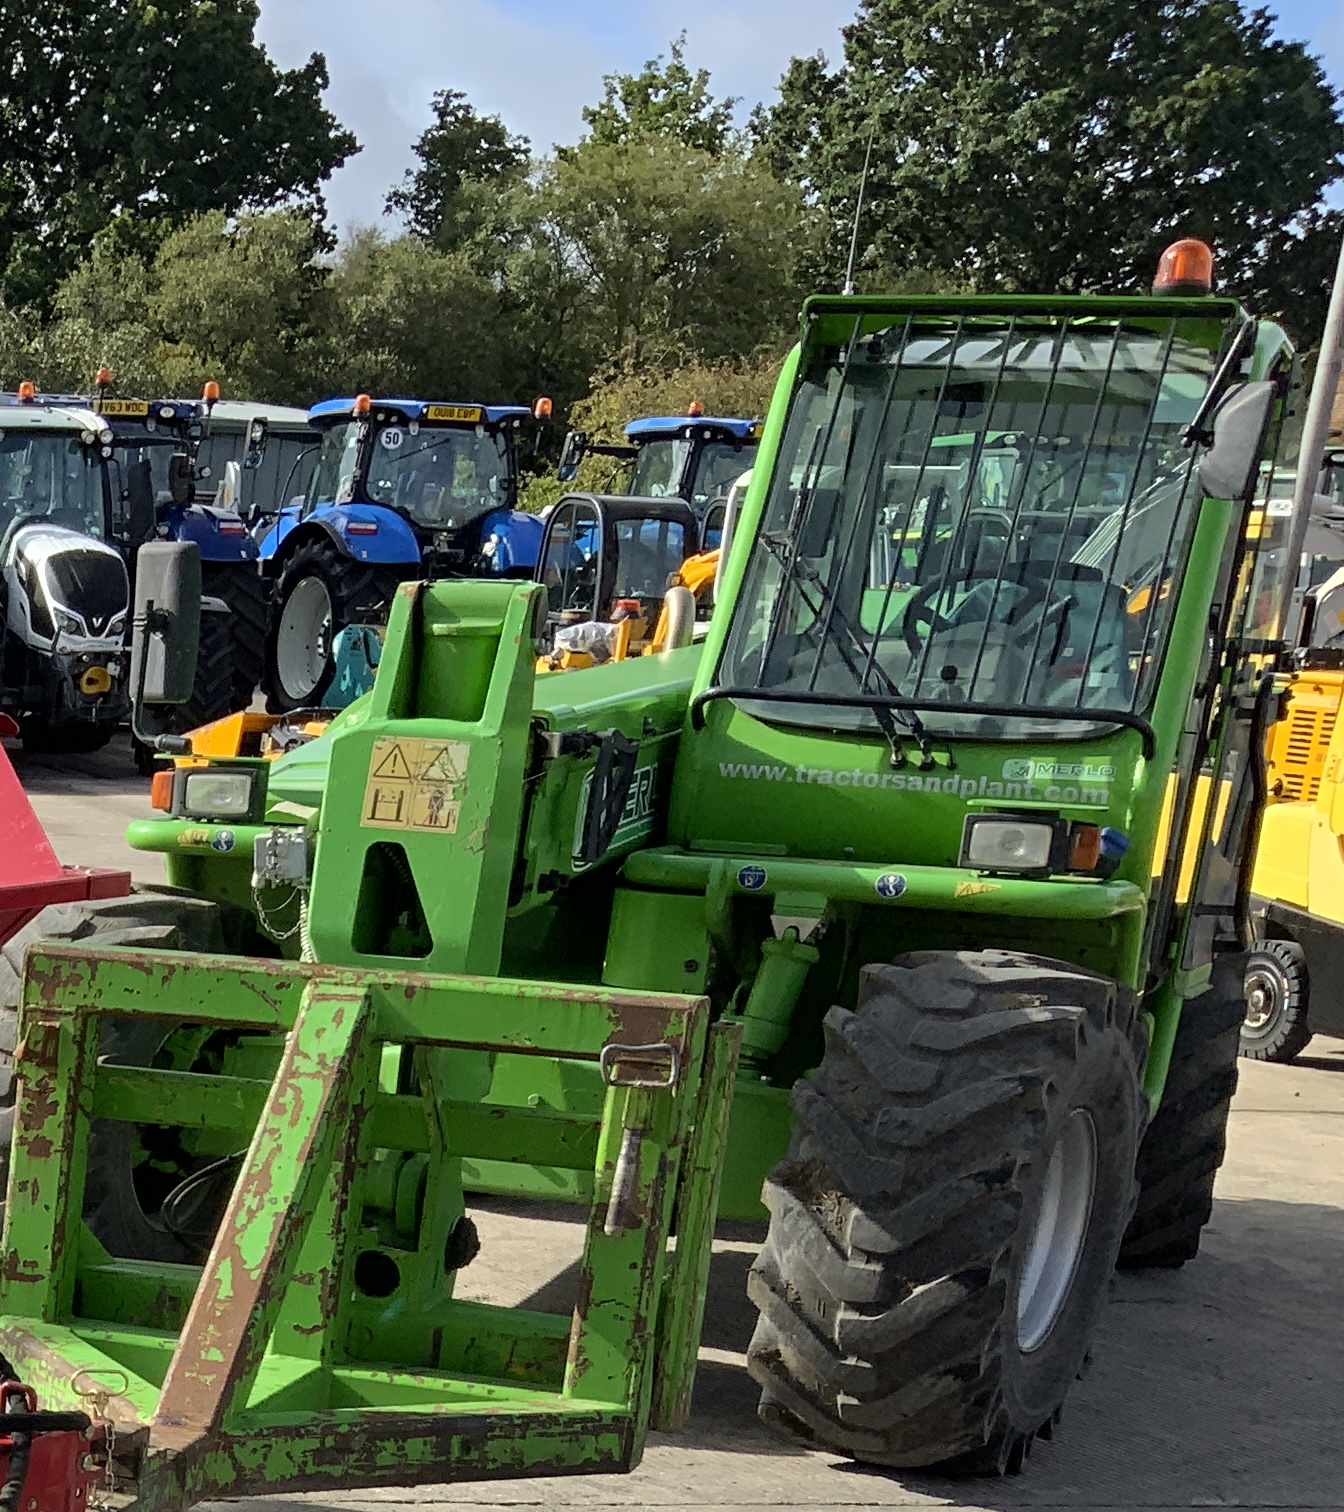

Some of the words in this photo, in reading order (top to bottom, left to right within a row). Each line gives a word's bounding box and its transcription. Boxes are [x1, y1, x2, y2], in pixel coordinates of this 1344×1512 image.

[385, 432, 400, 445] 50
[1036, 763, 1115, 777] MERLO
[719, 761, 1109, 804] www.tractorsandplant.com
